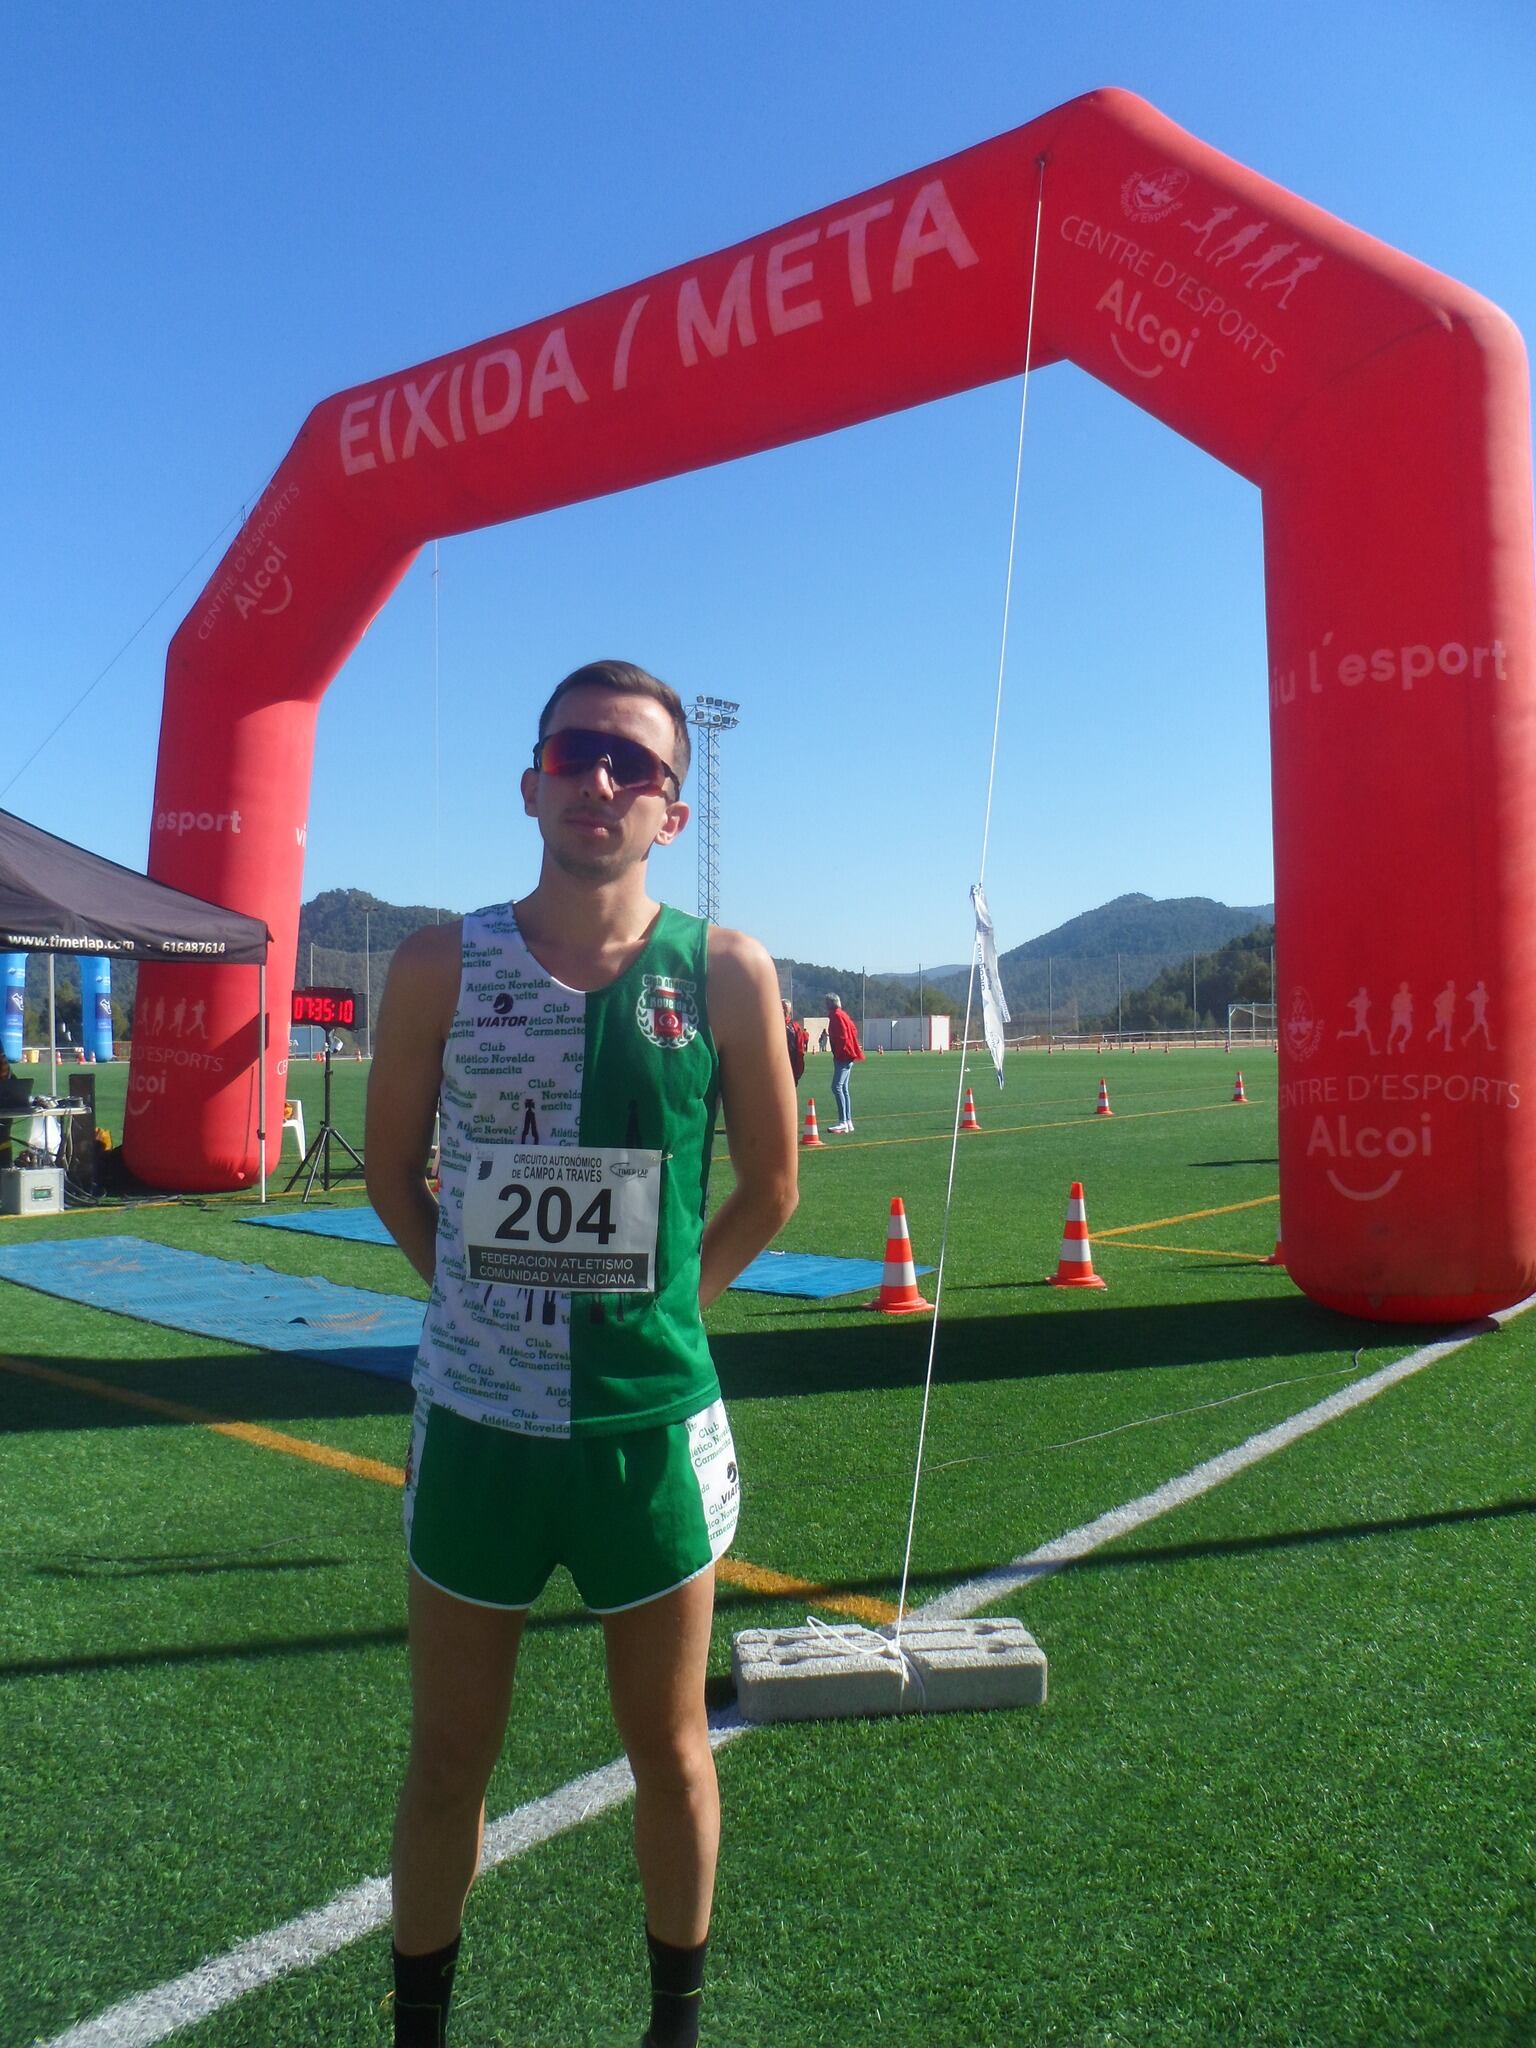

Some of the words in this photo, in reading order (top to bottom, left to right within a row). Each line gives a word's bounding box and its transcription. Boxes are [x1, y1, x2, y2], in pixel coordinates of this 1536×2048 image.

[1060, 215, 1155, 277] CENTRE
[1153, 261, 1285, 375] D'ESPORTS
[339, 327, 589, 476] EIXIDA
[612, 294, 650, 391] /
[676, 179, 979, 368] META
[1095, 278, 1200, 369] Alcoi
[234, 541, 287, 620] Alcoi
[8, 935, 135, 951] www.timerlap.com
[162, 941, 226, 954] 616487614
[463, 947, 503, 961] Novelda
[495, 969, 522, 979] Club
[466, 982, 507, 994] Atlético
[508, 979, 551, 993] Novelda
[543, 1002, 571, 1014] Club
[476, 1016, 529, 1028] VIATOR
[479, 1042, 506, 1054] Club
[491, 1053, 535, 1064] Novelda
[464, 1064, 523, 1075] Carmencita
[527, 1078, 556, 1090] Club
[1348, 1074, 1521, 1109] D'ESPORTS
[473, 1113, 496, 1125] Club
[1306, 1112, 1432, 1158] Alcoi
[513, 1153, 549, 1166] CIRCUITO
[512, 1169, 521, 1179] DE
[524, 1166, 555, 1180] CAMPO
[557, 1168, 563, 1181] A
[494, 1184, 617, 1245] 204
[560, 1258, 634, 1270] ATLETISMO
[479, 1265, 550, 1282] COMUNIDAD
[552, 1272, 636, 1285] VALENCIANA
[525, 1337, 553, 1349] Club
[468, 1363, 496, 1377] Club
[509, 1358, 571, 1371] Carmencita
[452, 1381, 510, 1402] Carmencita
[479, 1377, 522, 1393] Novelda
[511, 1408, 540, 1420] Club
[480, 1413, 522, 1429] Atlético
[524, 1421, 571, 1434] Novelda
[699, 1422, 721, 1439] Club
